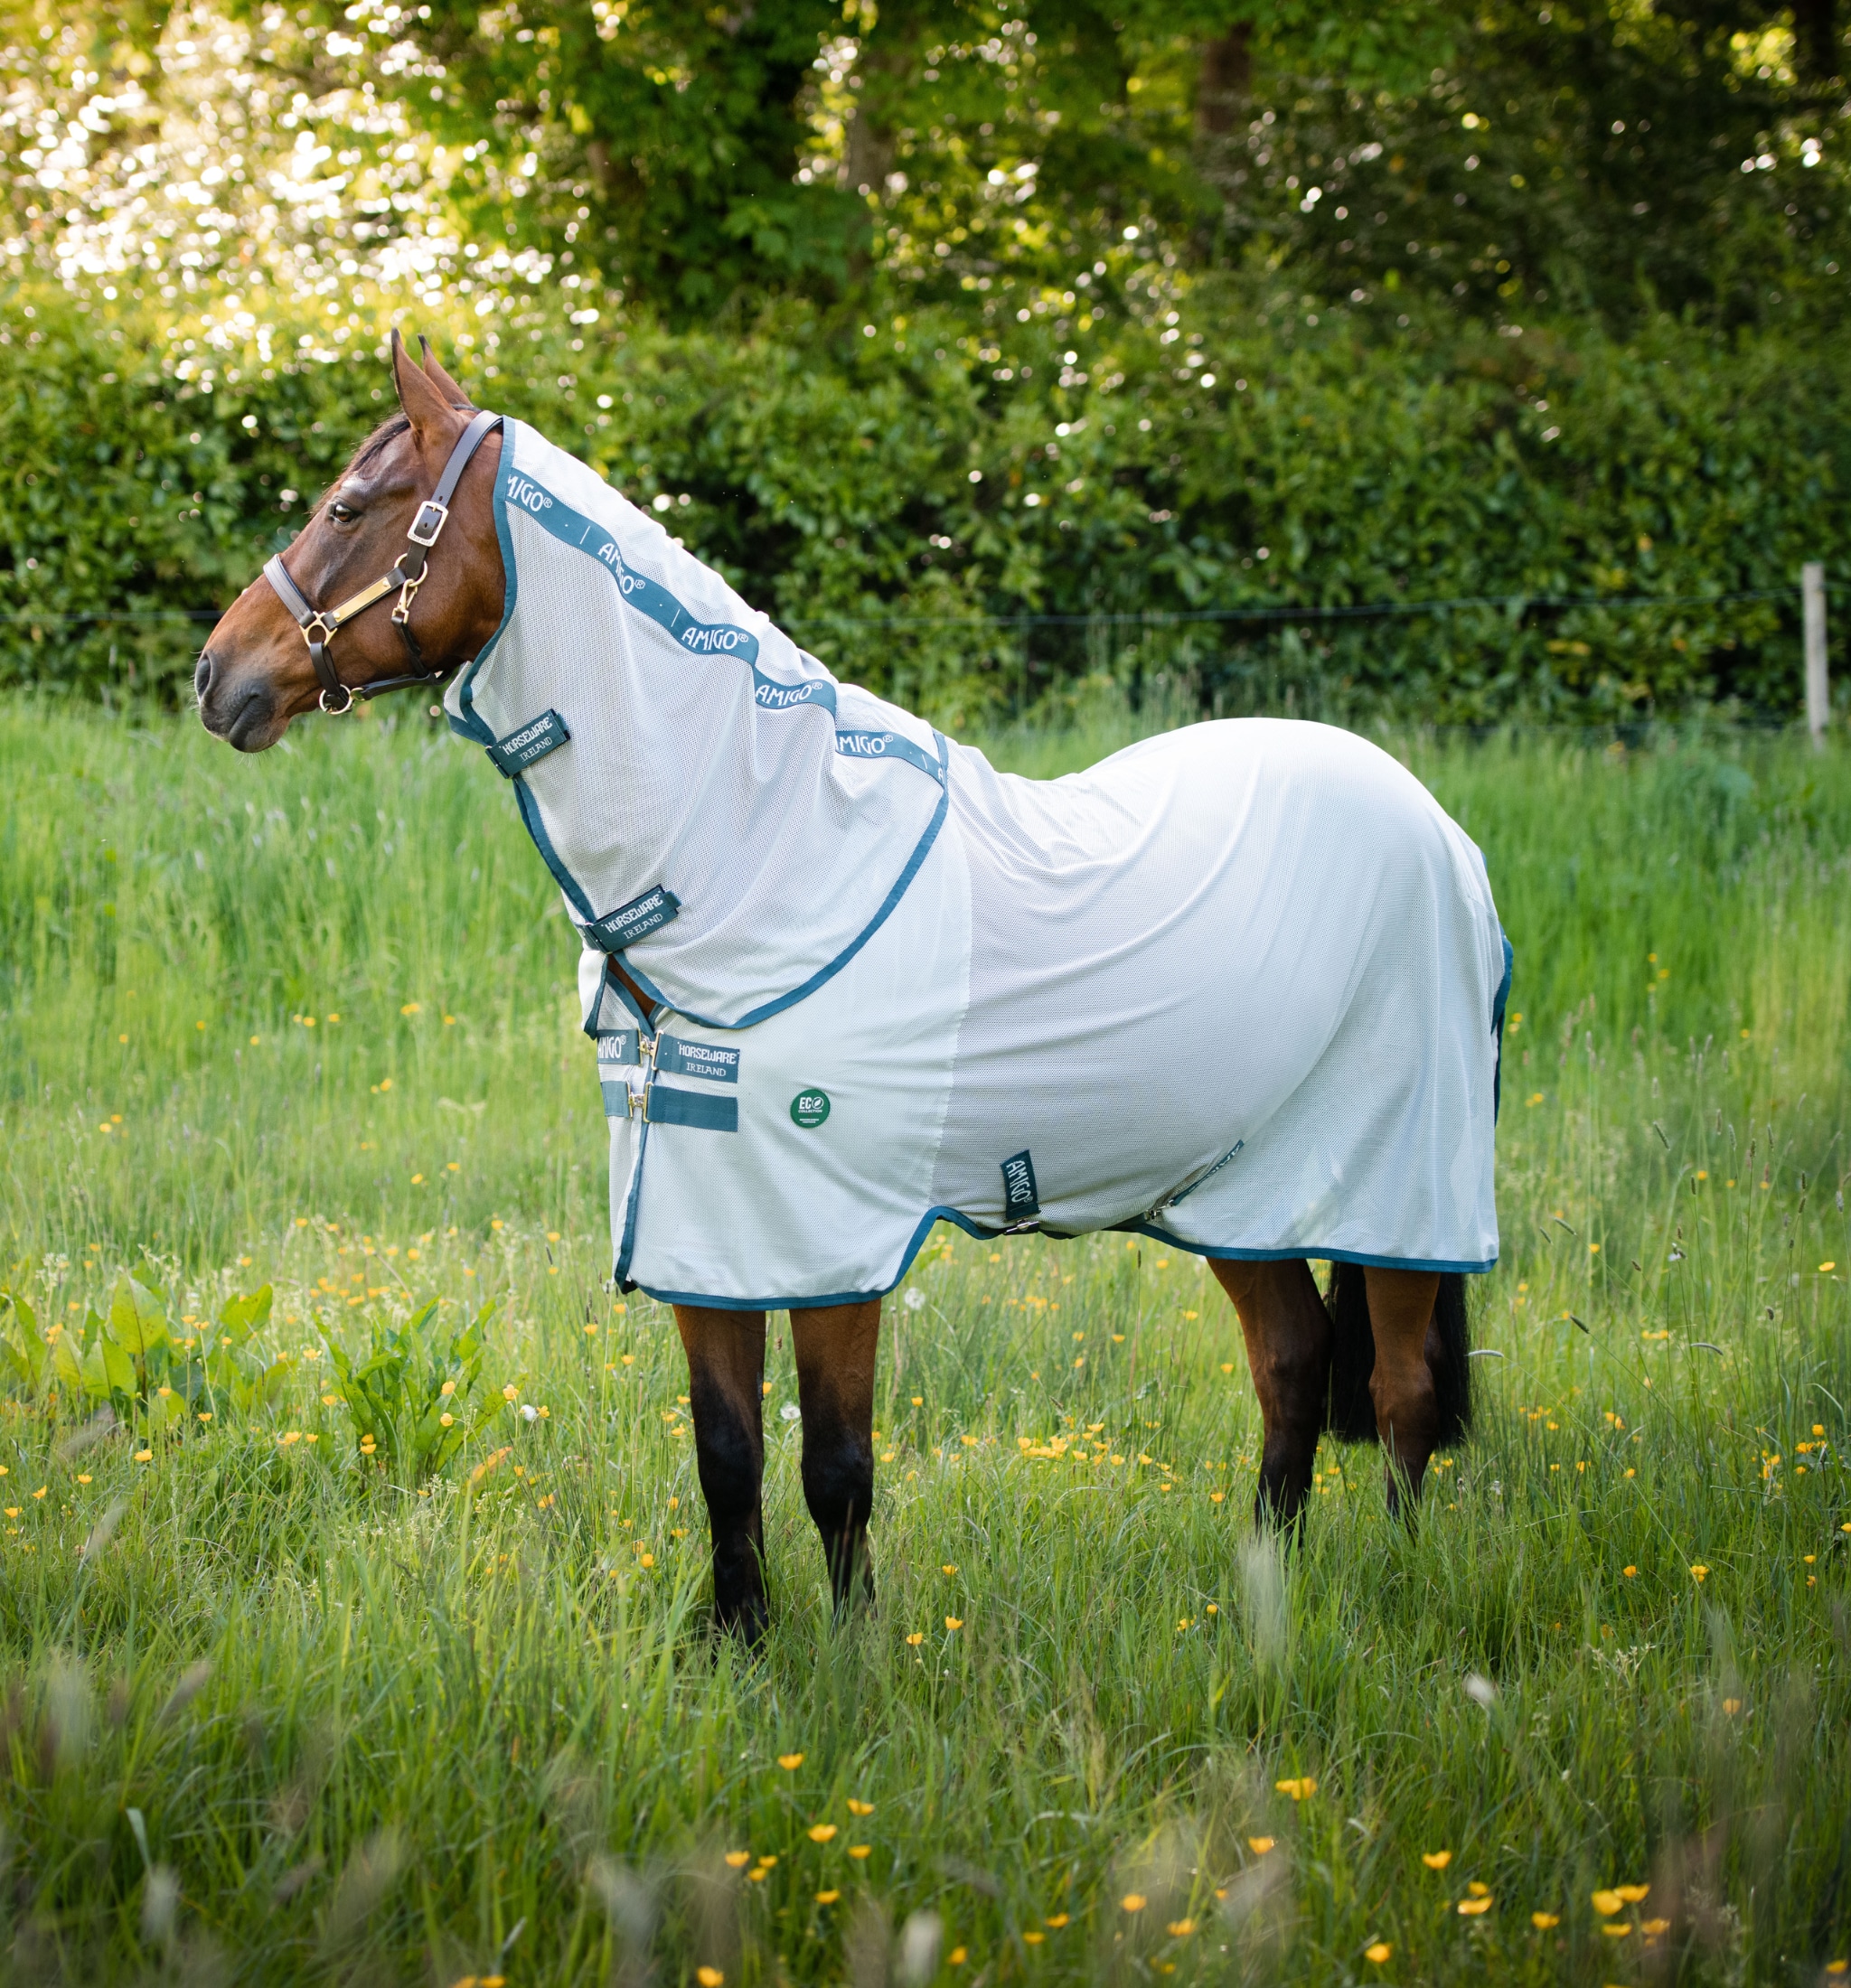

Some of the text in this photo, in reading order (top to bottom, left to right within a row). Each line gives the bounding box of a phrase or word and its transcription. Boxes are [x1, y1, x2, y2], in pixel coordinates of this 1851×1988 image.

[507, 474, 553, 512] MIGO®
[502, 717, 553, 755] HORSEWARE
[835, 735, 894, 755] MIGO®
[518, 736, 553, 763] IRELAND
[605, 894, 663, 933] HORSEWARE
[624, 913, 663, 939] IRELAND
[679, 1045, 737, 1064] HORSEWARE
[686, 1062, 727, 1077] IRELAND
[798, 1096, 824, 1110] ECO
